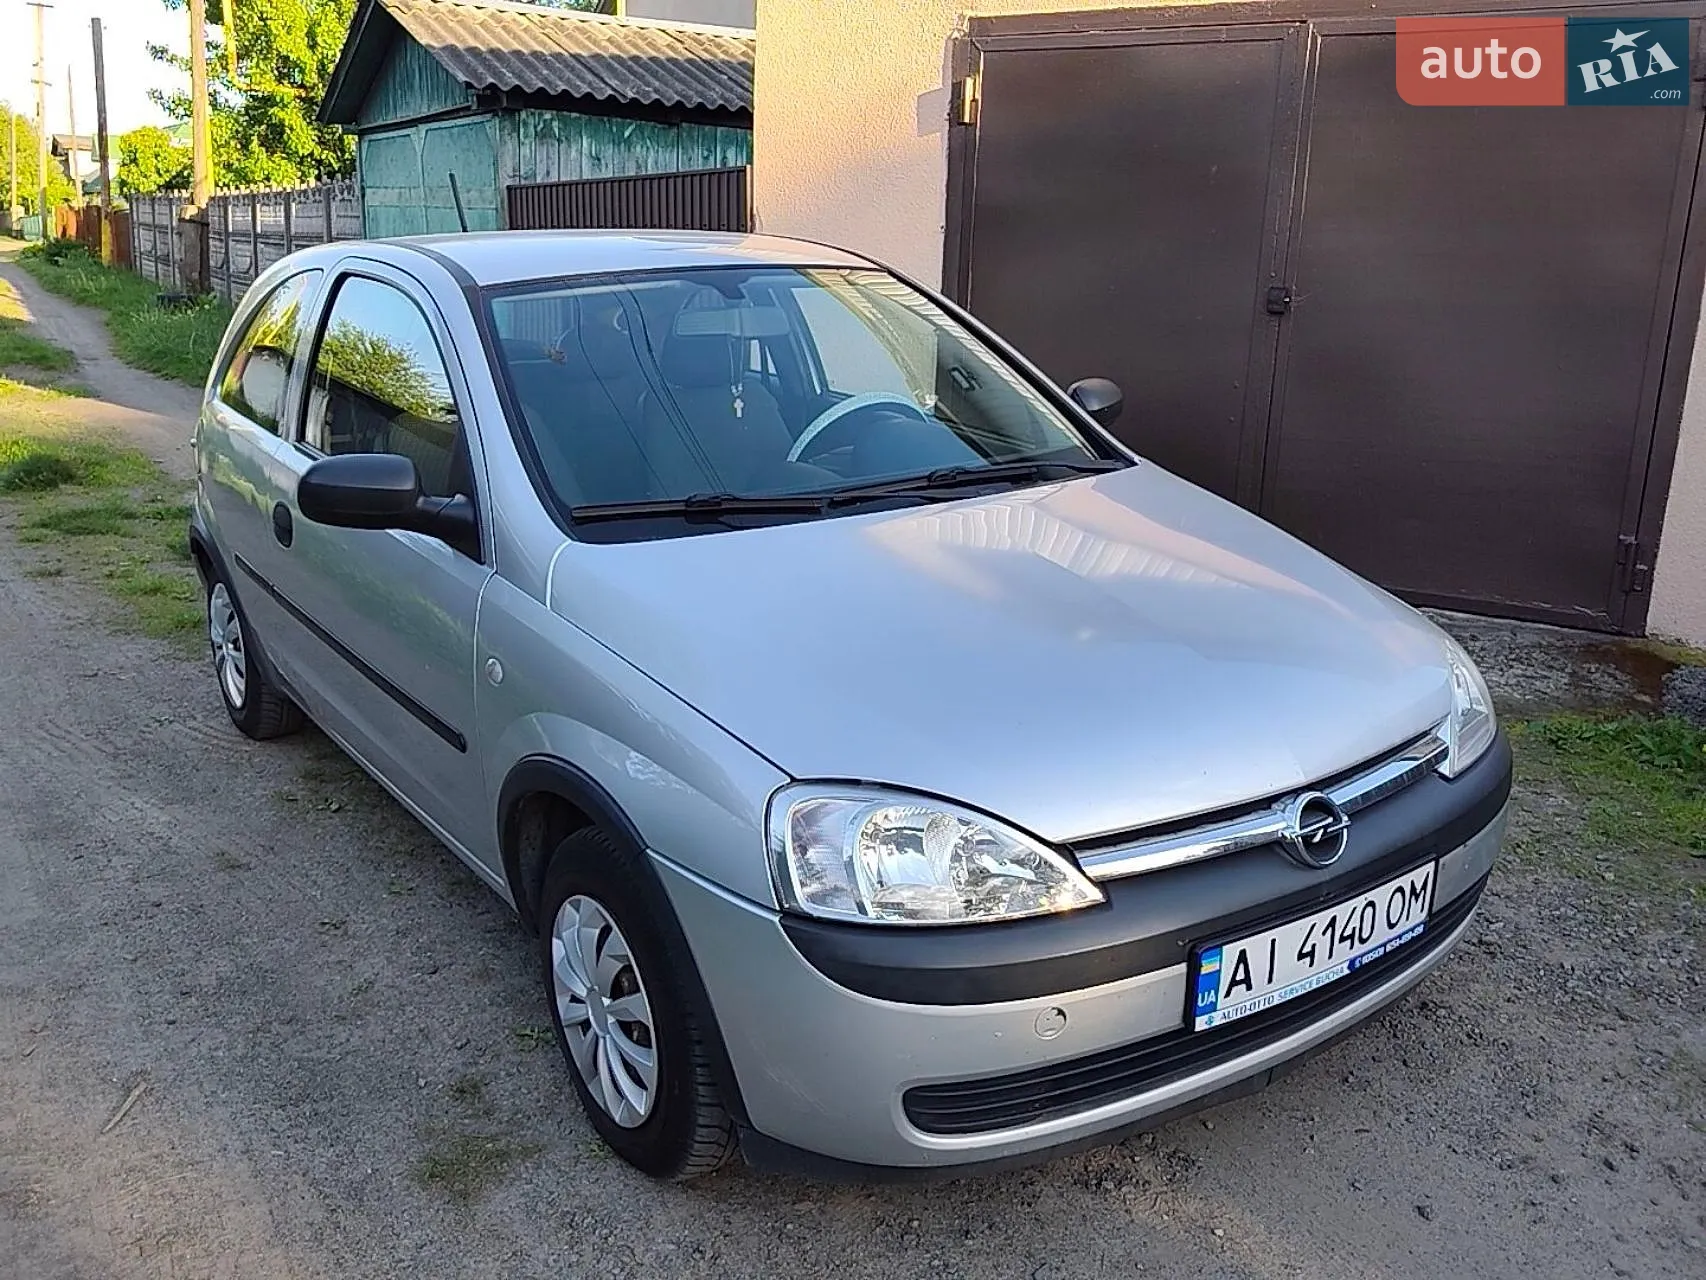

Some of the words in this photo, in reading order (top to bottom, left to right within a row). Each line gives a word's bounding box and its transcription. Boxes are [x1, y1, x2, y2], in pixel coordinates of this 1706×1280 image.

[1297, 900, 1377, 968] 4140
[1386, 871, 1431, 930] OM
[1197, 989, 1217, 1007] UA
[1277, 980, 1314, 1001] SERVICE
